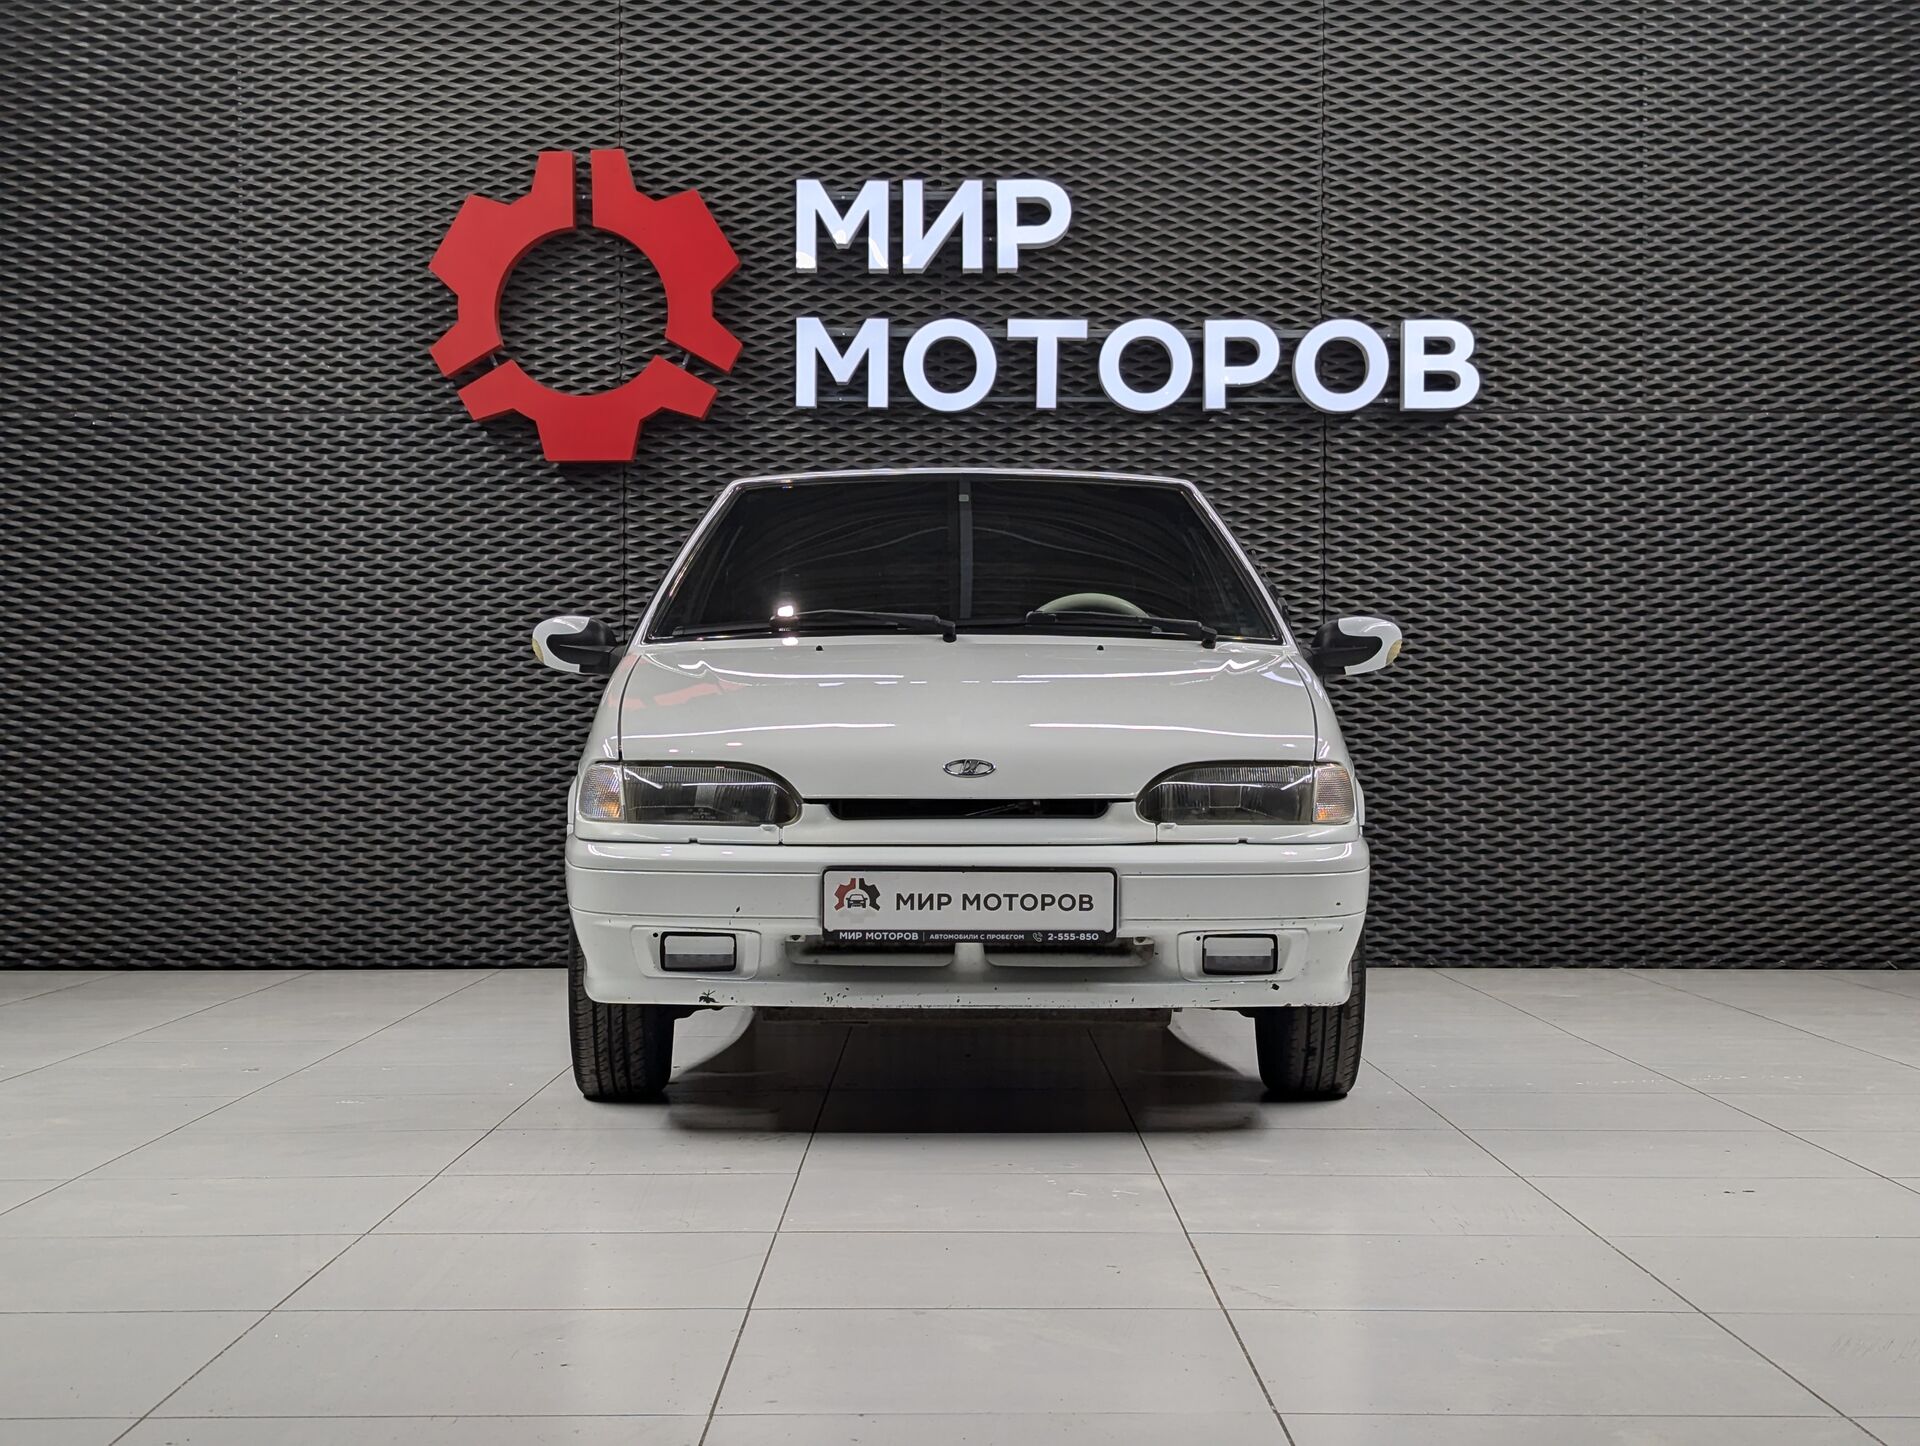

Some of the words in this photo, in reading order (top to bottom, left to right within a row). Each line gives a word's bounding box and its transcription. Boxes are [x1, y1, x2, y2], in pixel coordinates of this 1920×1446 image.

[795, 178, 1073, 275] МИР
[795, 317, 1481, 413] МОТОРОВ
[895, 893, 952, 911] МИР
[961, 893, 1094, 911] МОТОРОВ
[839, 932, 863, 940] МИР
[865, 932, 919, 940] МОТОРОВ
[1047, 933, 1099, 941] 2-555-850
